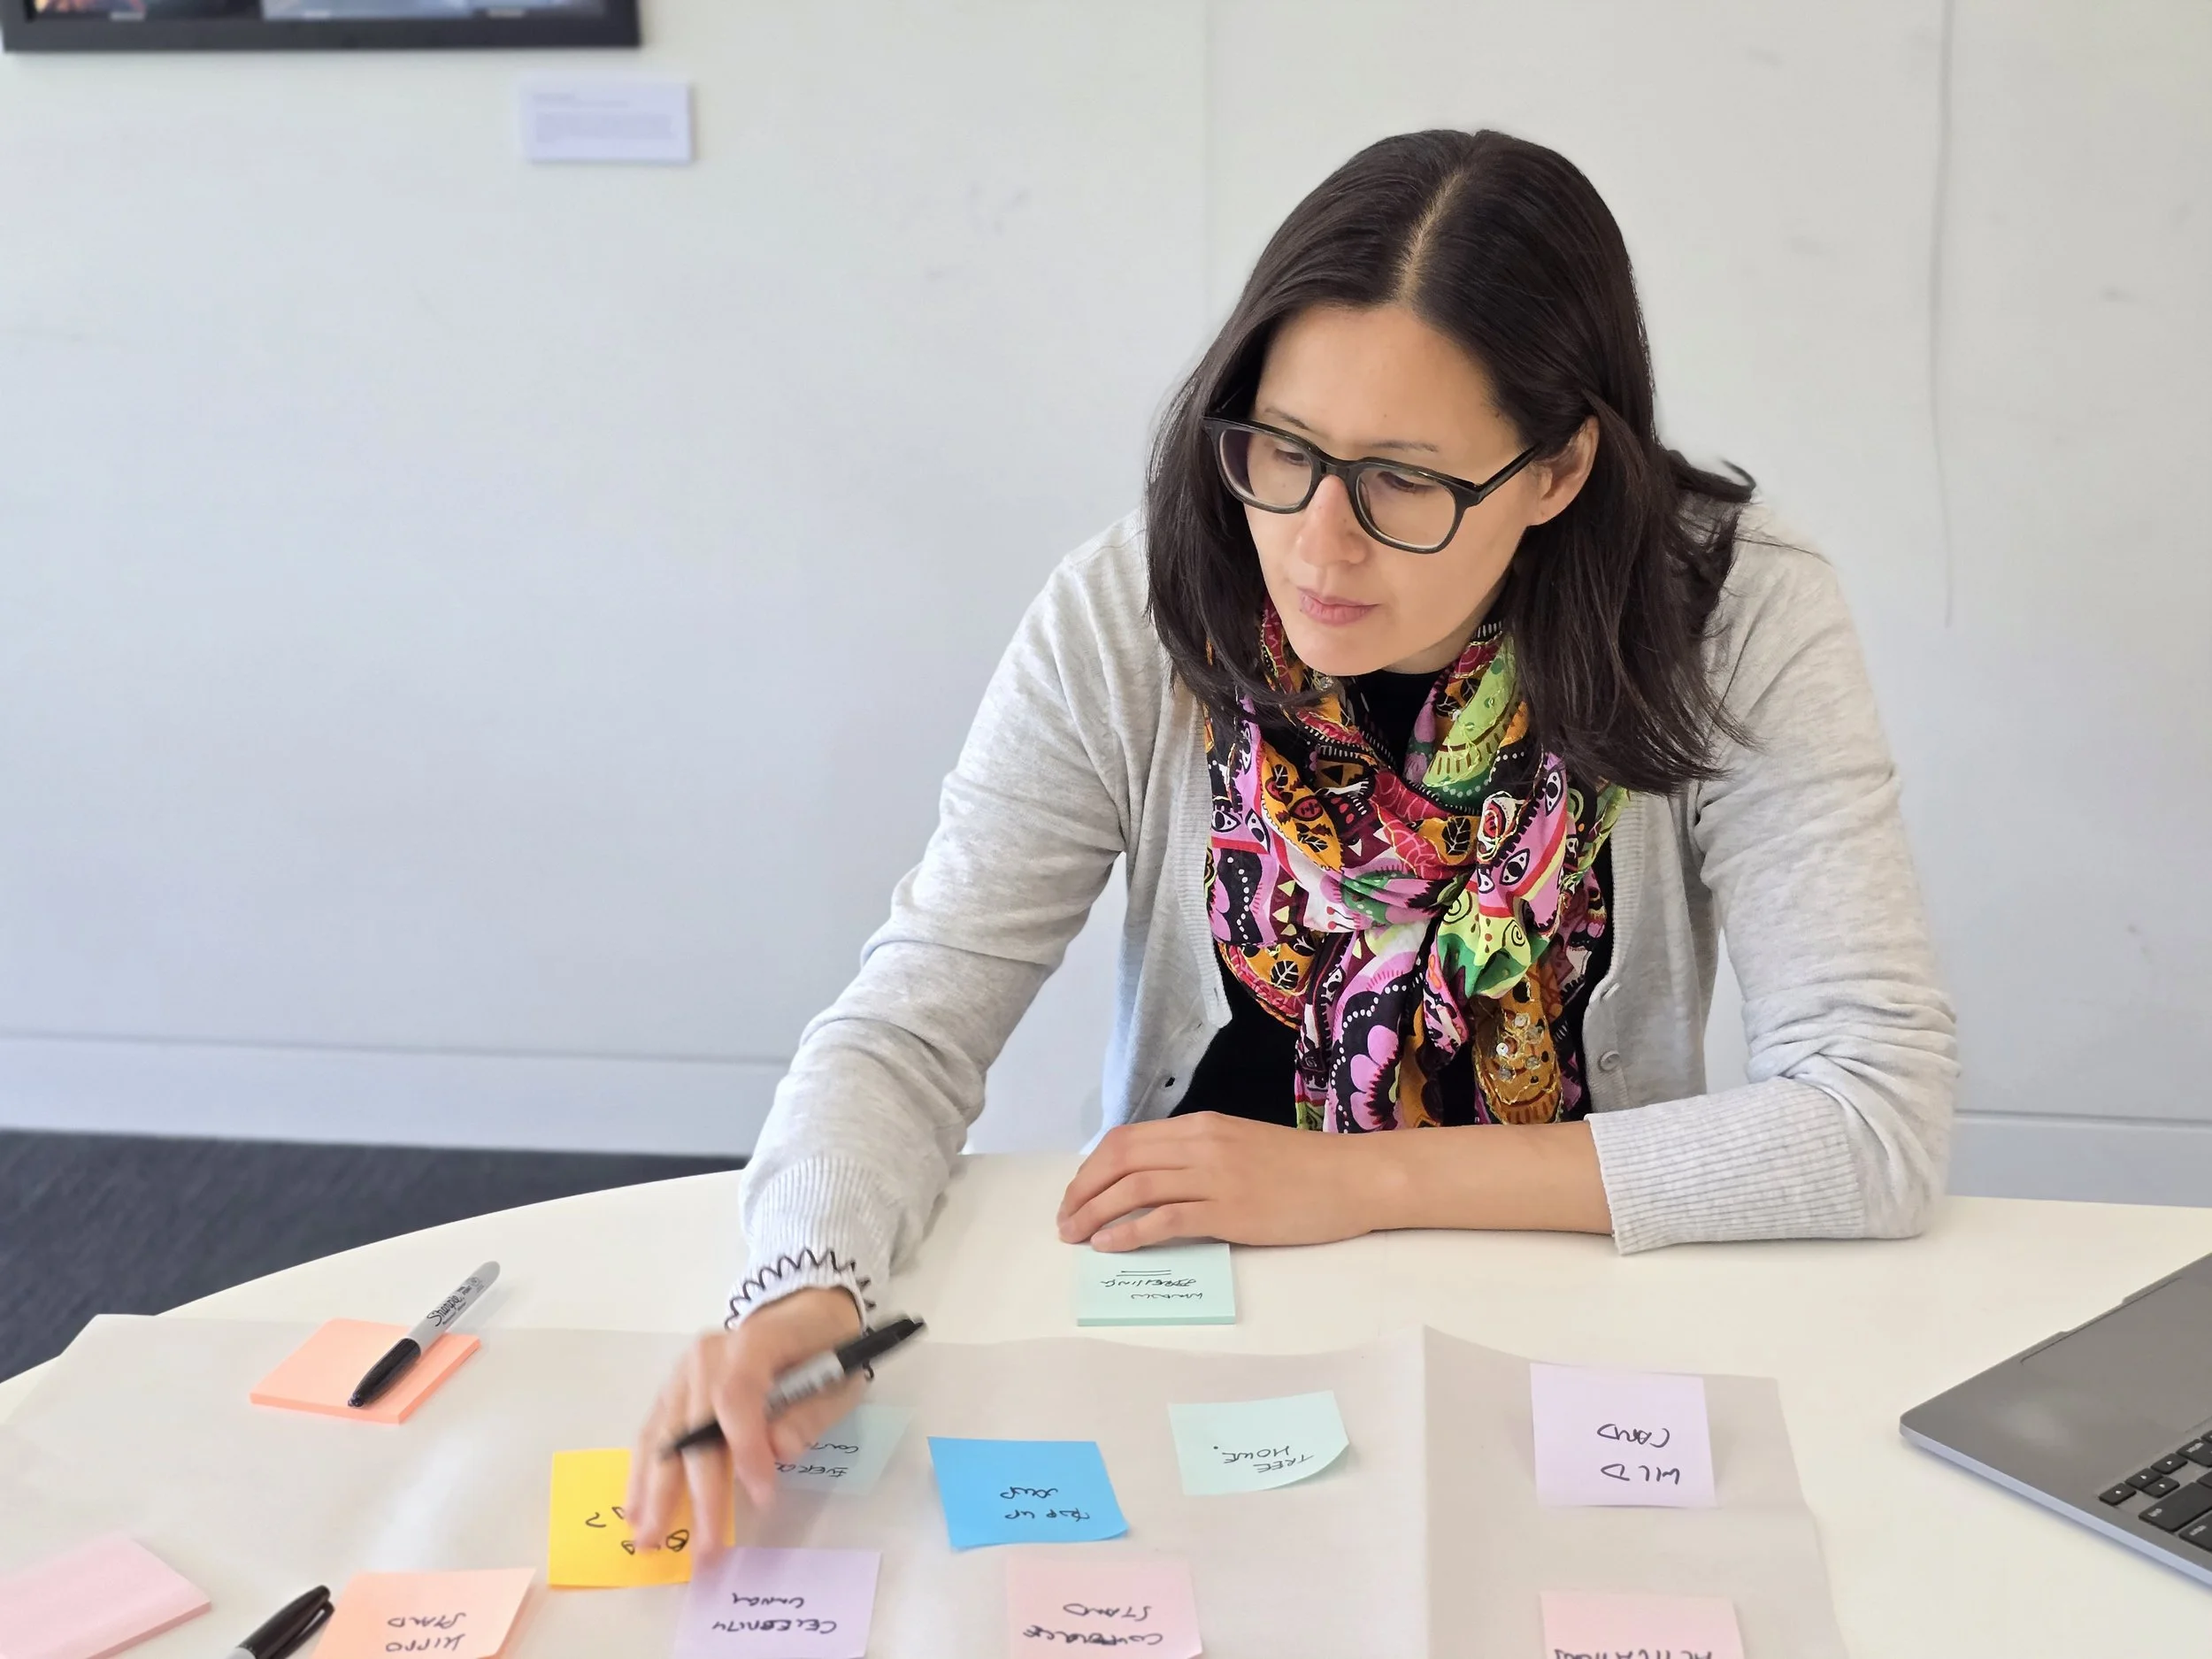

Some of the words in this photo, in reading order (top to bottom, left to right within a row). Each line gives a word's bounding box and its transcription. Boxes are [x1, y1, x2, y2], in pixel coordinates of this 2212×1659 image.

[1596, 1423, 1670, 1448] CARD
[1253, 1454, 1313, 1472] TREE
[1601, 1463, 1680, 1486] WILD
[1063, 1603, 1151, 1622] STAND
